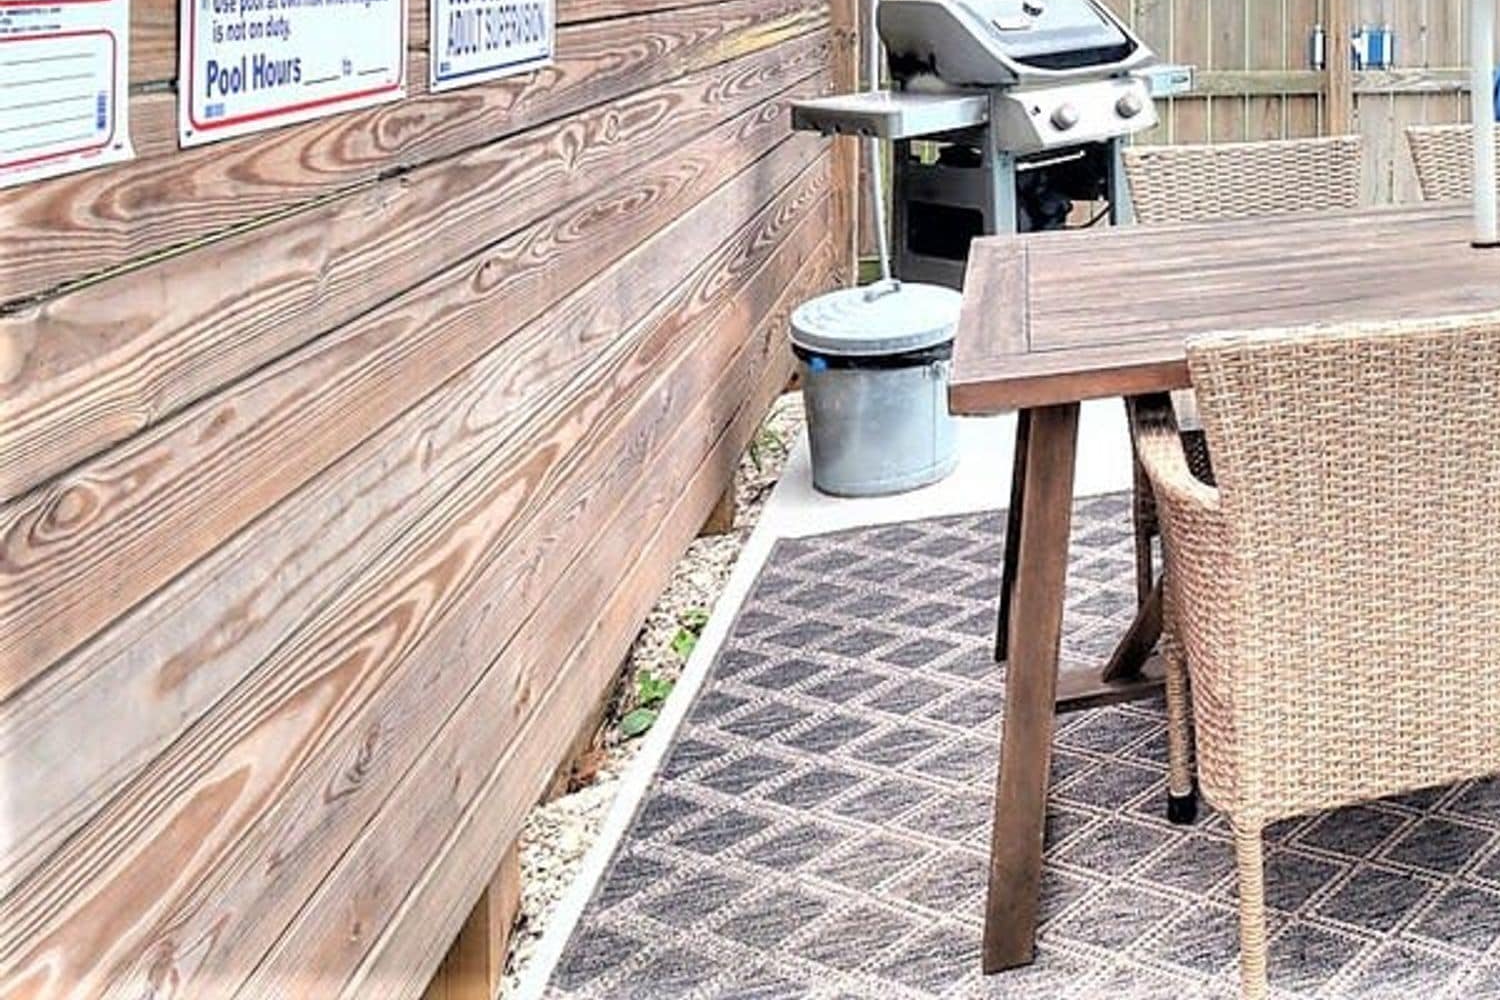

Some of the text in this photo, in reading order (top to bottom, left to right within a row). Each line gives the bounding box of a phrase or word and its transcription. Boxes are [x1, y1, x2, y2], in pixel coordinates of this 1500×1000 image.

[213, 19, 224, 43] is
[226, 21, 247, 41] not
[249, 22, 263, 40] on
[446, 3, 546, 55] ADULT SUPERVISION
[207, 55, 247, 99] Pool
[252, 53, 302, 91] Hours
